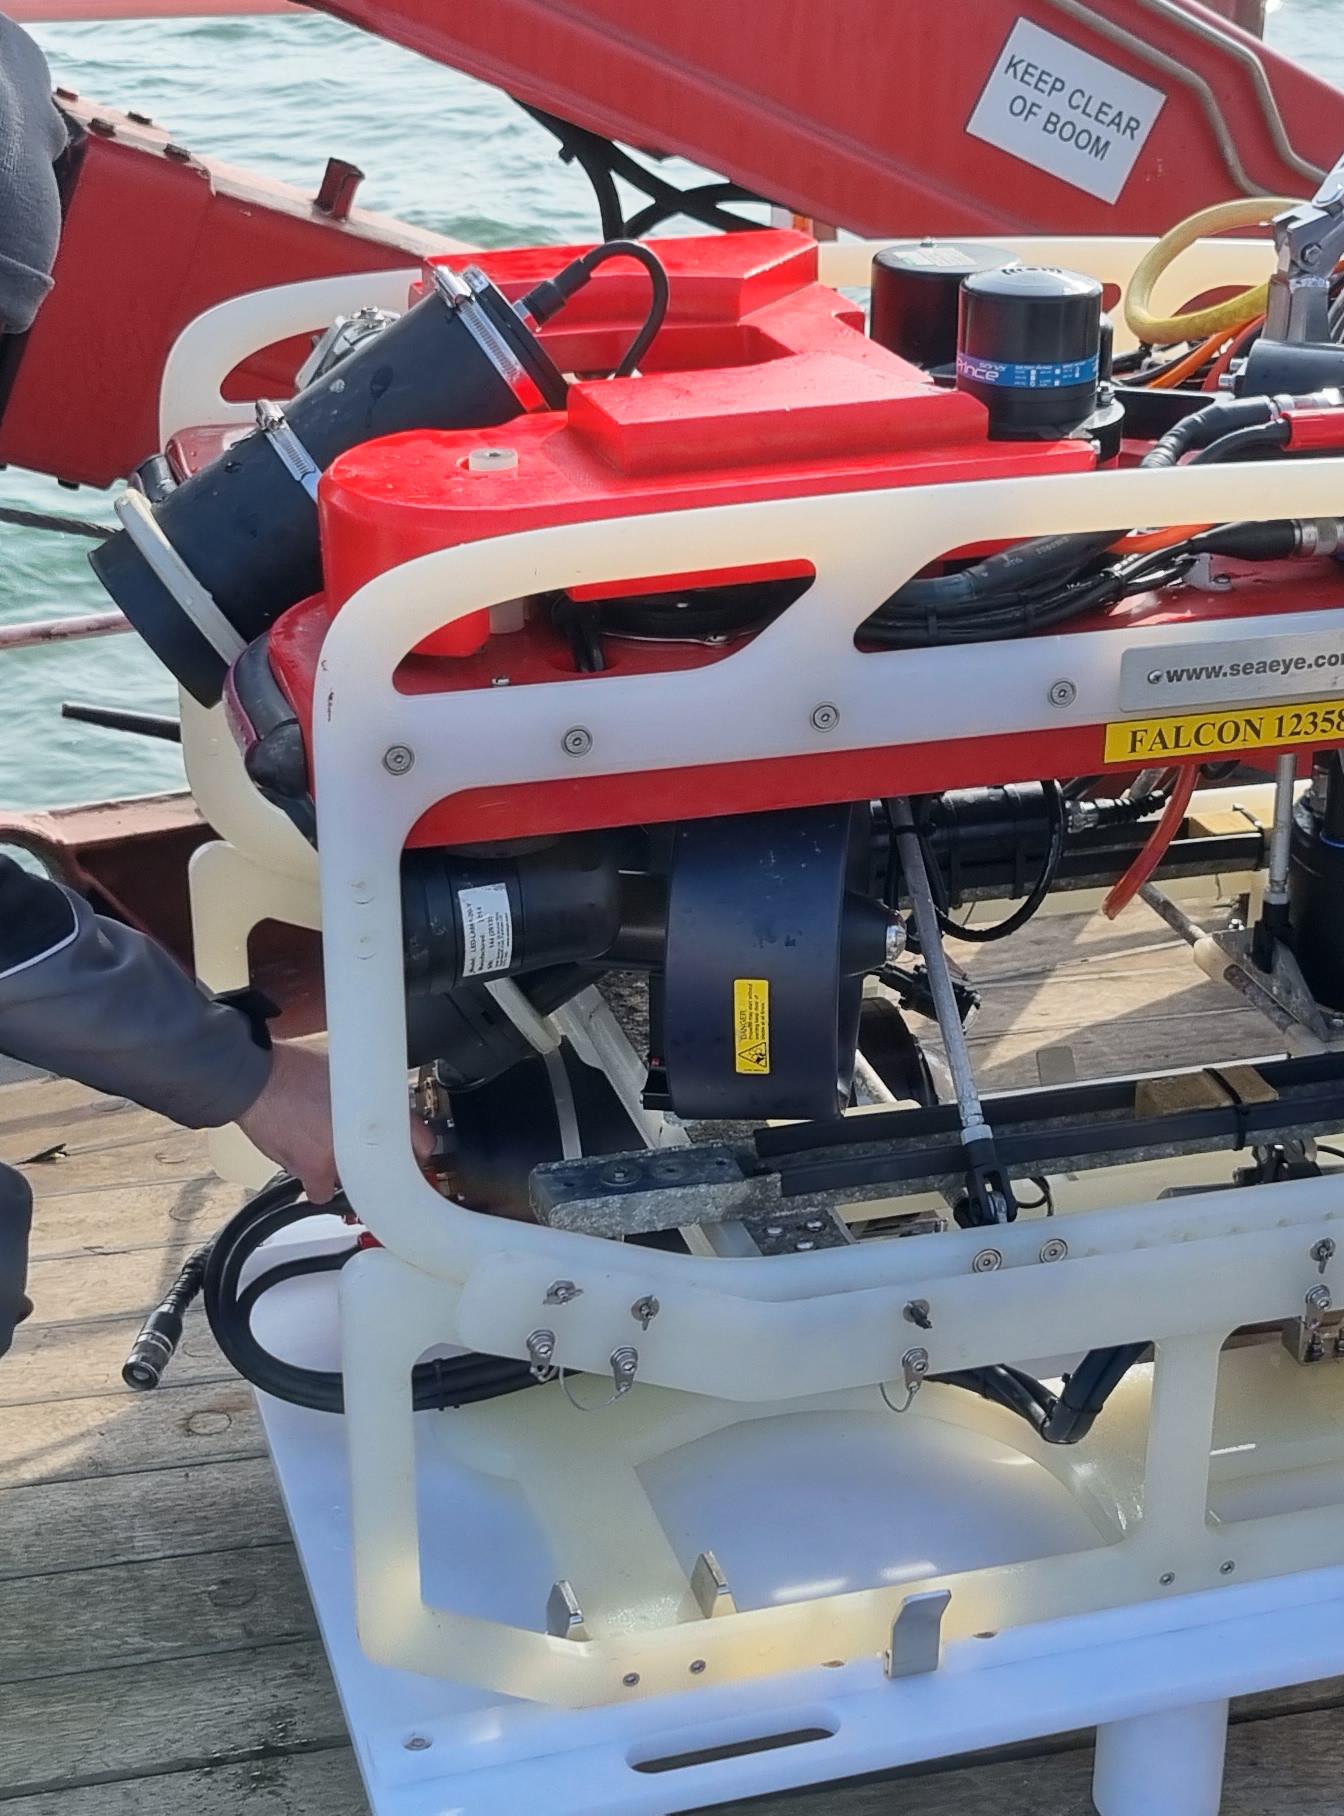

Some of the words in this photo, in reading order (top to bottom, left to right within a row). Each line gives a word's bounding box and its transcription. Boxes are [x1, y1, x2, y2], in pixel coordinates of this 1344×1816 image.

[1003, 54, 1065, 97] KEEP
[1067, 88, 1142, 140] CLEAR
[1008, 95, 1043, 123] OF
[1042, 112, 1111, 161] BOOM
[1128, 716, 1264, 754] FALCON
[739, 1010, 747, 1040] DANGER
